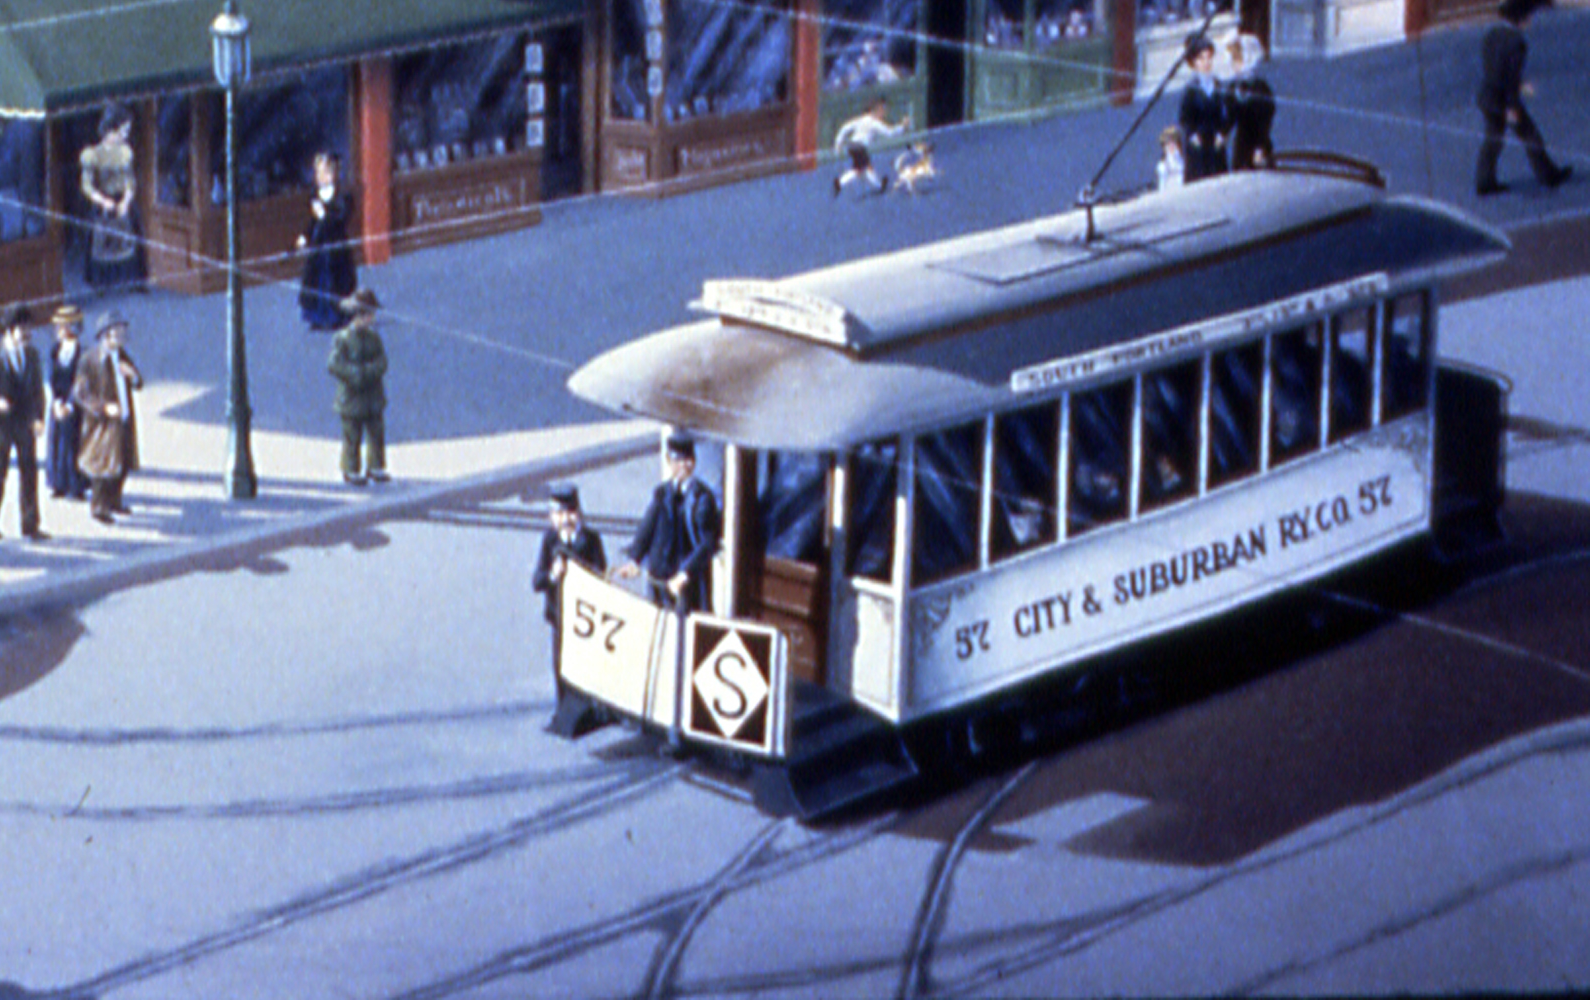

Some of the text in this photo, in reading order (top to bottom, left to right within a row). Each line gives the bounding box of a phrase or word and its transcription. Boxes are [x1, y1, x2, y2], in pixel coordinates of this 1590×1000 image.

[955, 619, 991, 660] 57
[1013, 590, 1072, 638] CITY
[1081, 584, 1102, 616] &
[1113, 524, 1267, 605] SUBURBAN
[1358, 475, 1393, 515] 57
[573, 598, 626, 653] 57
[712, 651, 748, 720] S
